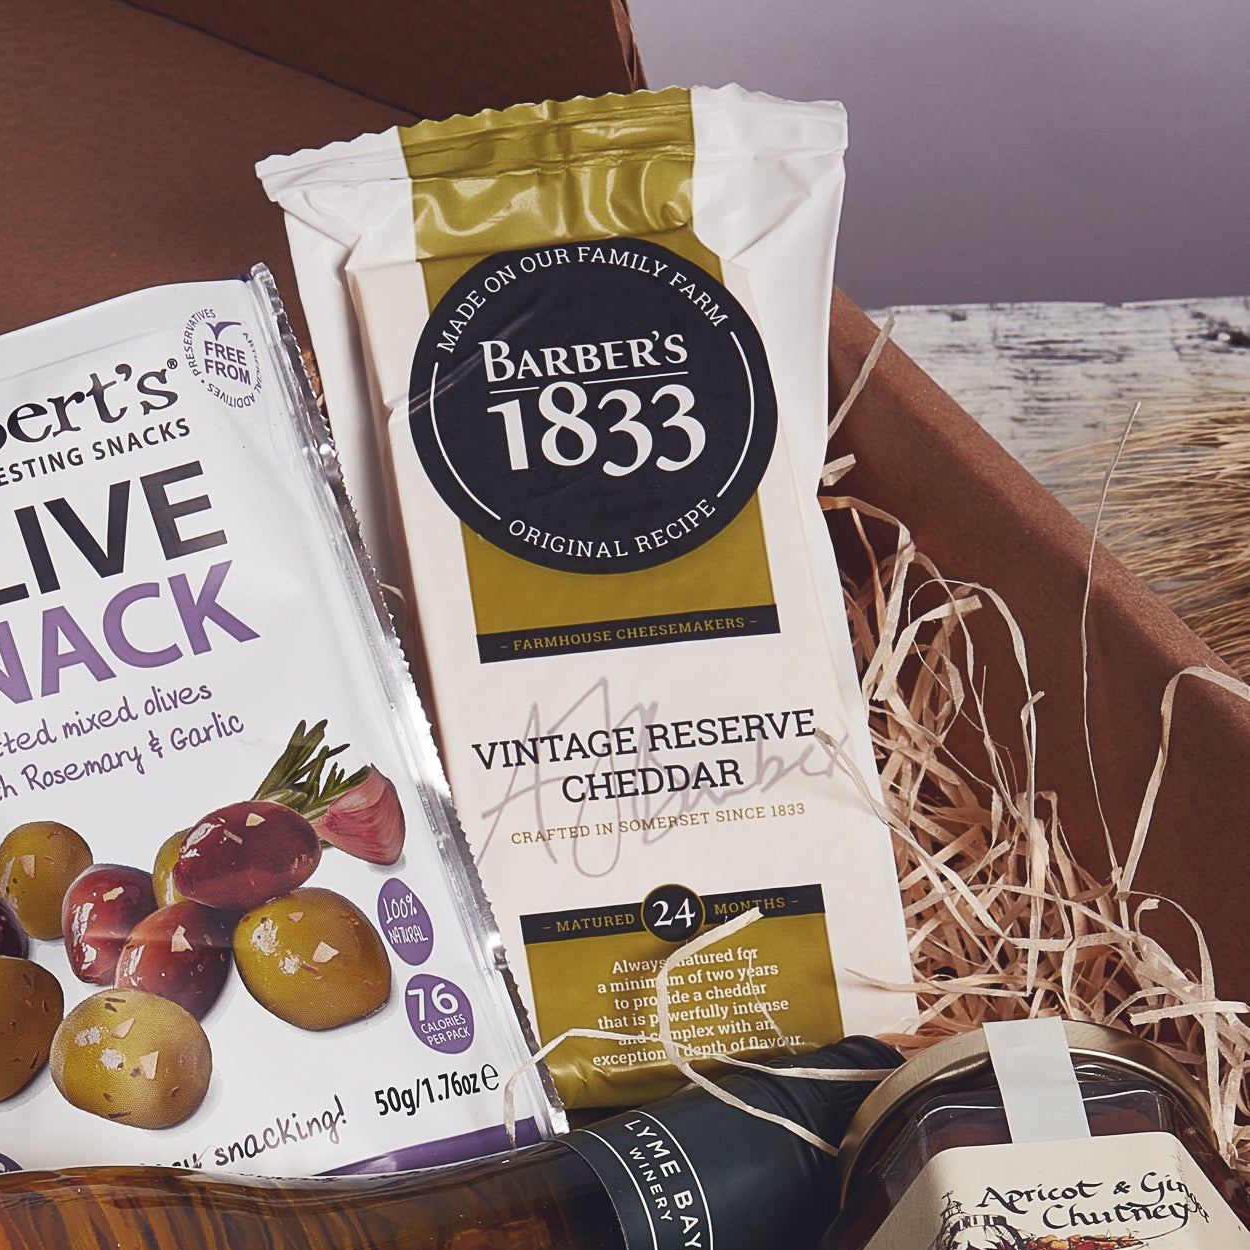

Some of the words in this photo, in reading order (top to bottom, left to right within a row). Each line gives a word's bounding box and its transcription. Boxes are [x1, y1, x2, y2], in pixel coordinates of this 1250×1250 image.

[437, 290, 486, 353] MADE
[484, 265, 517, 293] ON
[520, 248, 570, 273] OUR
[578, 247, 667, 278] FAMILY
[668, 272, 728, 327] FARM
[183, 308, 216, 376] PRESERVATIVES
[204, 340, 247, 366] FREE
[204, 358, 251, 386] FROM
[207, 383, 256, 408] ADDITIVES
[92, 416, 192, 461] SNACKS
[487, 381, 706, 477] 1833
[508, 519, 629, 558] ORIGINAL
[635, 499, 716, 553] RECIPE
[513, 629, 612, 652] FARMHOUSE
[616, 617, 745, 641] CHEESEMAKERS
[62, 692, 139, 739] mixed
[143, 681, 213, 717] olives
[22, 743, 144, 792] Rosemary
[170, 713, 245, 753] Garlic
[472, 726, 638, 770] VINTAGE
[645, 708, 816, 753] RESERVE
[562, 759, 744, 803] CHEDDAR
[510, 825, 590, 845] CRAFTED
[596, 822, 614, 836] IN
[619, 811, 710, 833] SOMERSET
[715, 805, 766, 823] SINCE
[770, 802, 806, 817] 1833
[383, 892, 418, 924] 100%
[556, 912, 636, 933] MATURED
[652, 898, 696, 928] 24
[713, 897, 786, 915] MONTHS
[388, 924, 429, 946] NATURAL
[612, 959, 666, 974] Always
[736, 946, 758, 960] for
[597, 982, 607, 994] a
[610, 974, 685, 993] minimm
[688, 969, 703, 984] of
[705, 969, 735, 982] two
[737, 964, 779, 982] years
[407, 981, 459, 1021] 76
[614, 997, 630, 1010] to
[633, 990, 690, 1011] proide
[693, 991, 703, 1002] a
[705, 982, 767, 1000] cheddar
[420, 1013, 467, 1034] CALORIES
[597, 1015, 629, 1030] that
[632, 1012, 646, 1026] is
[649, 1003, 729, 1027] pwerfully
[733, 999, 789, 1015] intense
[650, 1024, 715, 1042] cmplex
[718, 1019, 752, 1035] with
[426, 1031, 447, 1046] PER
[446, 1026, 471, 1042] PACK
[592, 1045, 680, 1066] exceptionl
[730, 1037, 746, 1052] of
[214, 1094, 347, 1167] snacking!
[624, 1119, 681, 1178] LYME
[673, 1189, 702, 1249] BAY
[629, 1147, 673, 1221] WINERY
[975, 1180, 1104, 1214] Apricot
[1112, 1180, 1131, 1195] &
[1042, 1201, 1190, 1238] Chutney
